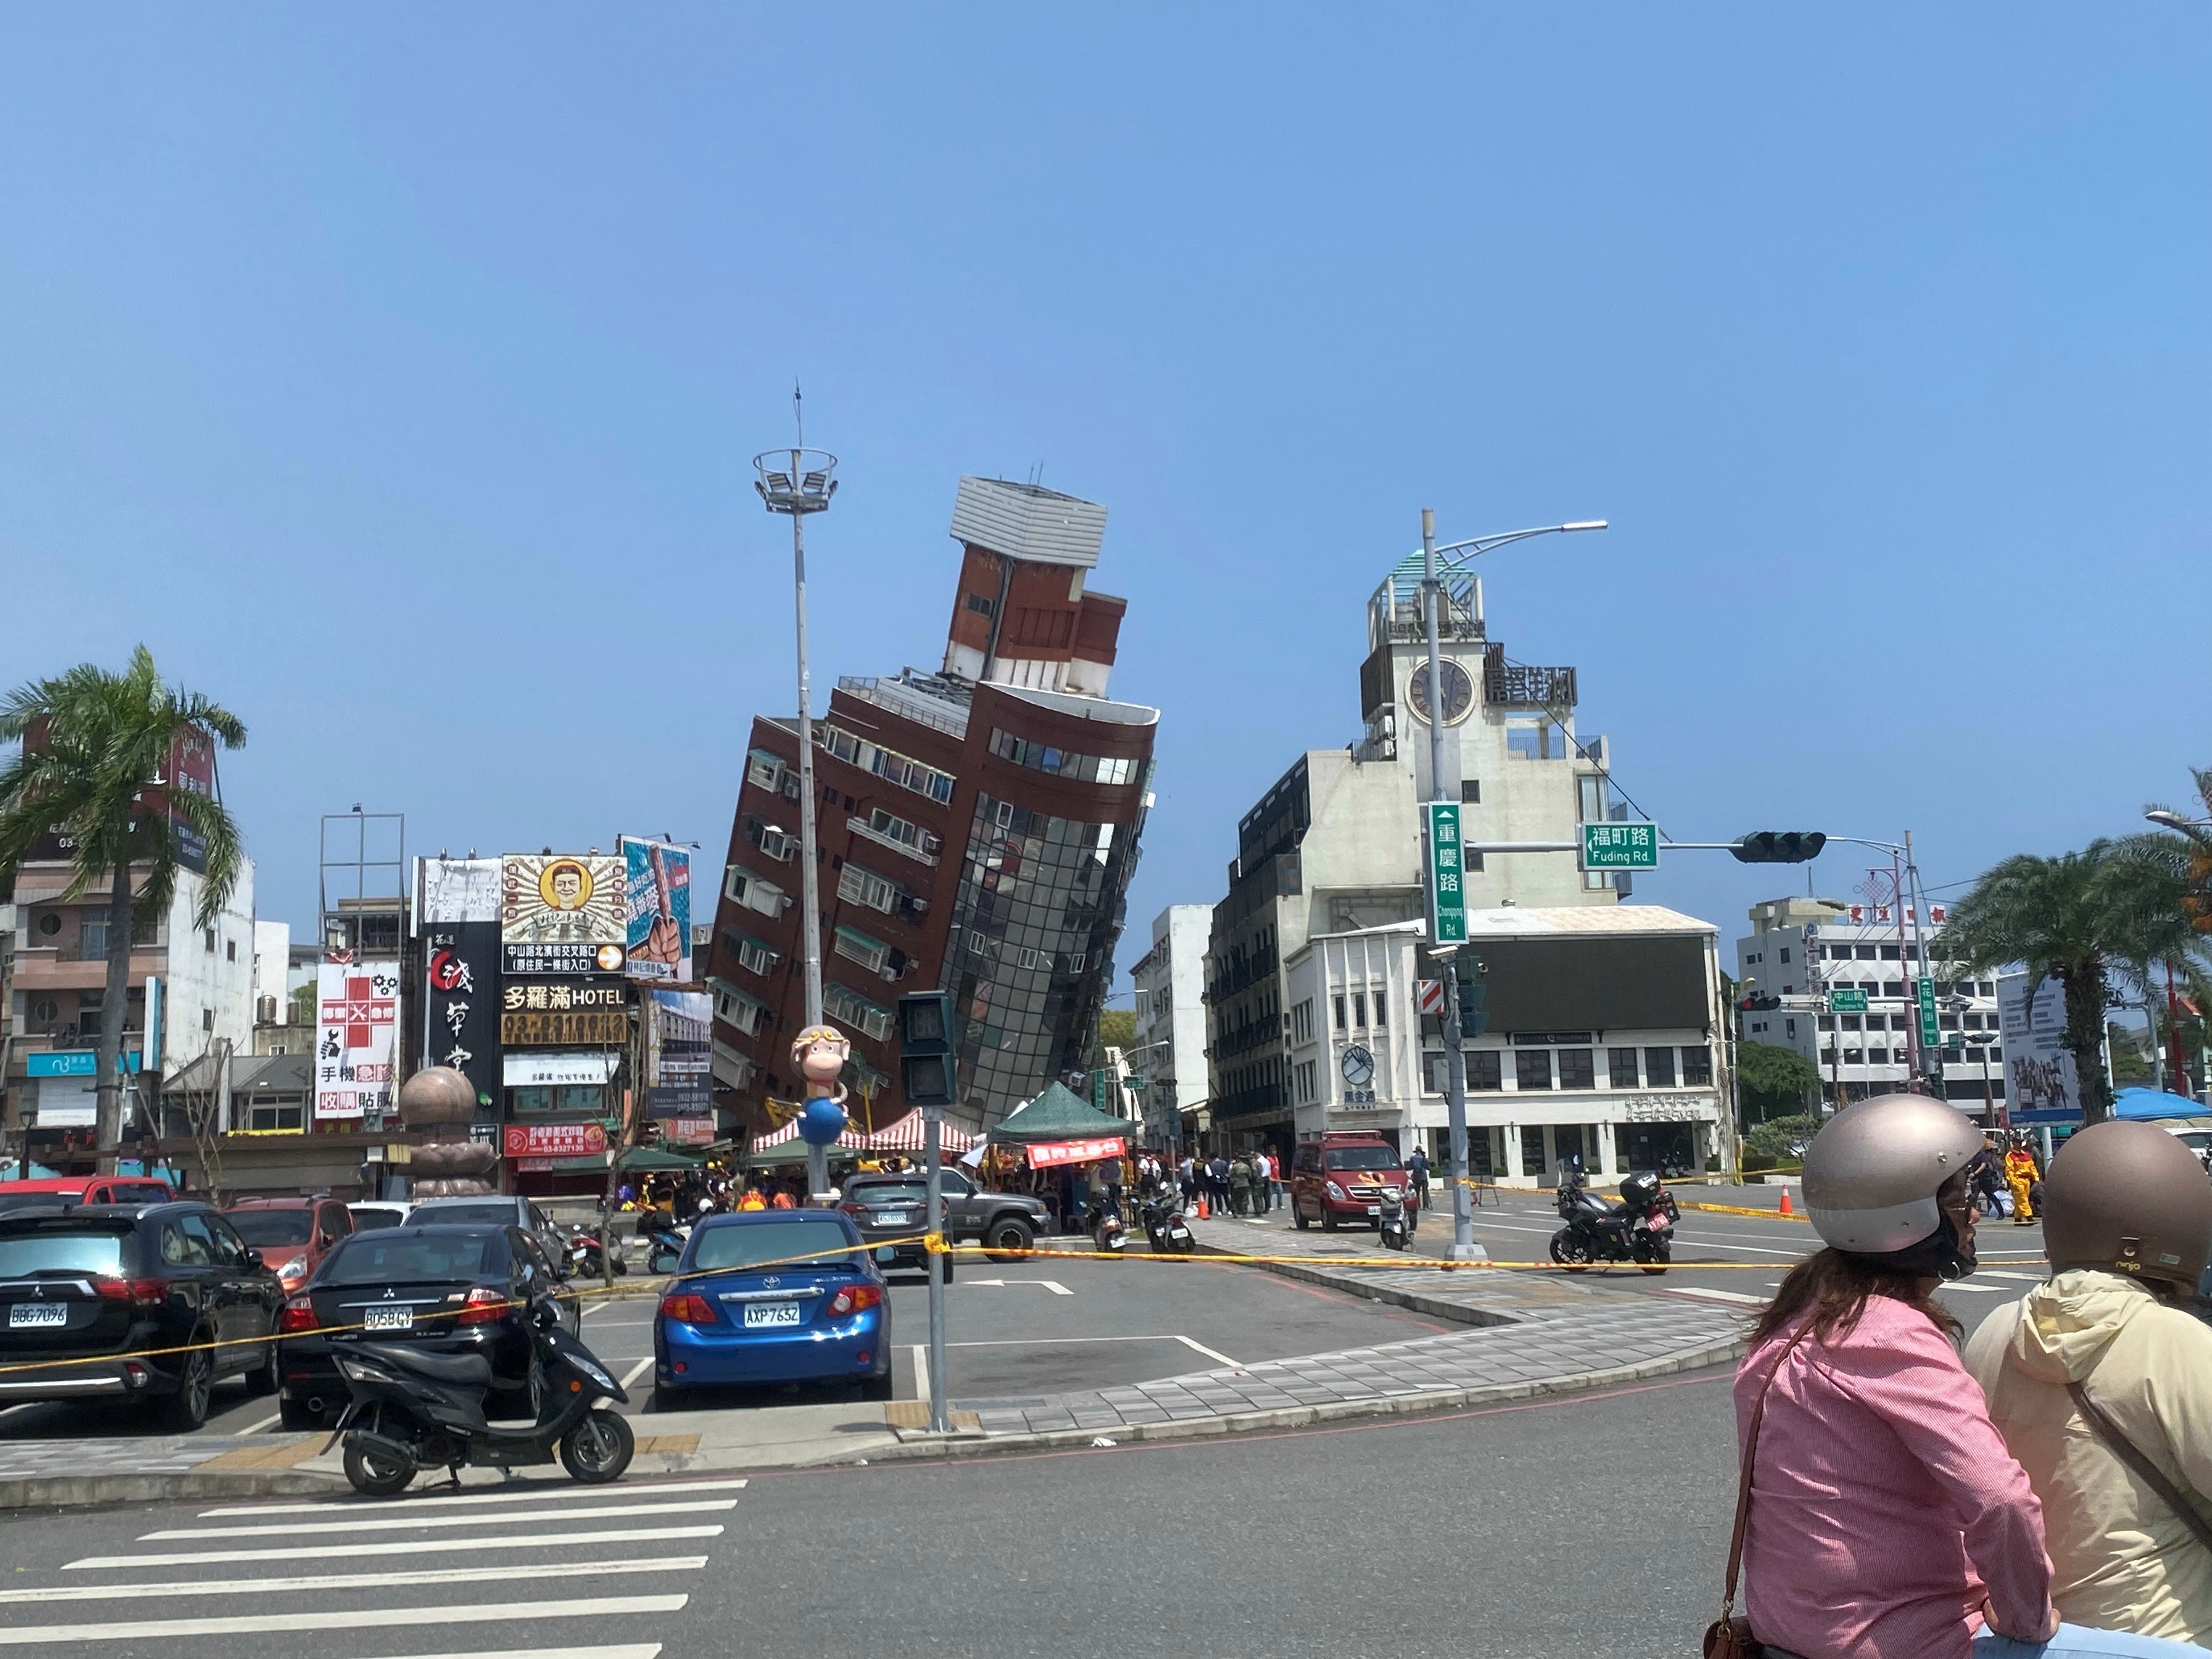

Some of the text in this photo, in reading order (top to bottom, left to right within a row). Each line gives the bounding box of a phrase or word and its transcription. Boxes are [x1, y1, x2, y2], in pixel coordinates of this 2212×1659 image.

[1592, 827, 1649, 846] 福町路
[1438, 823, 1458, 892] 重慶路
[1593, 850, 1630, 865] Fuding
[504, 985, 624, 1010] 多羅滿 HOTEL
[1834, 991, 1863, 1001] 中山路
[2116, 1261, 2141, 1271] ninja
